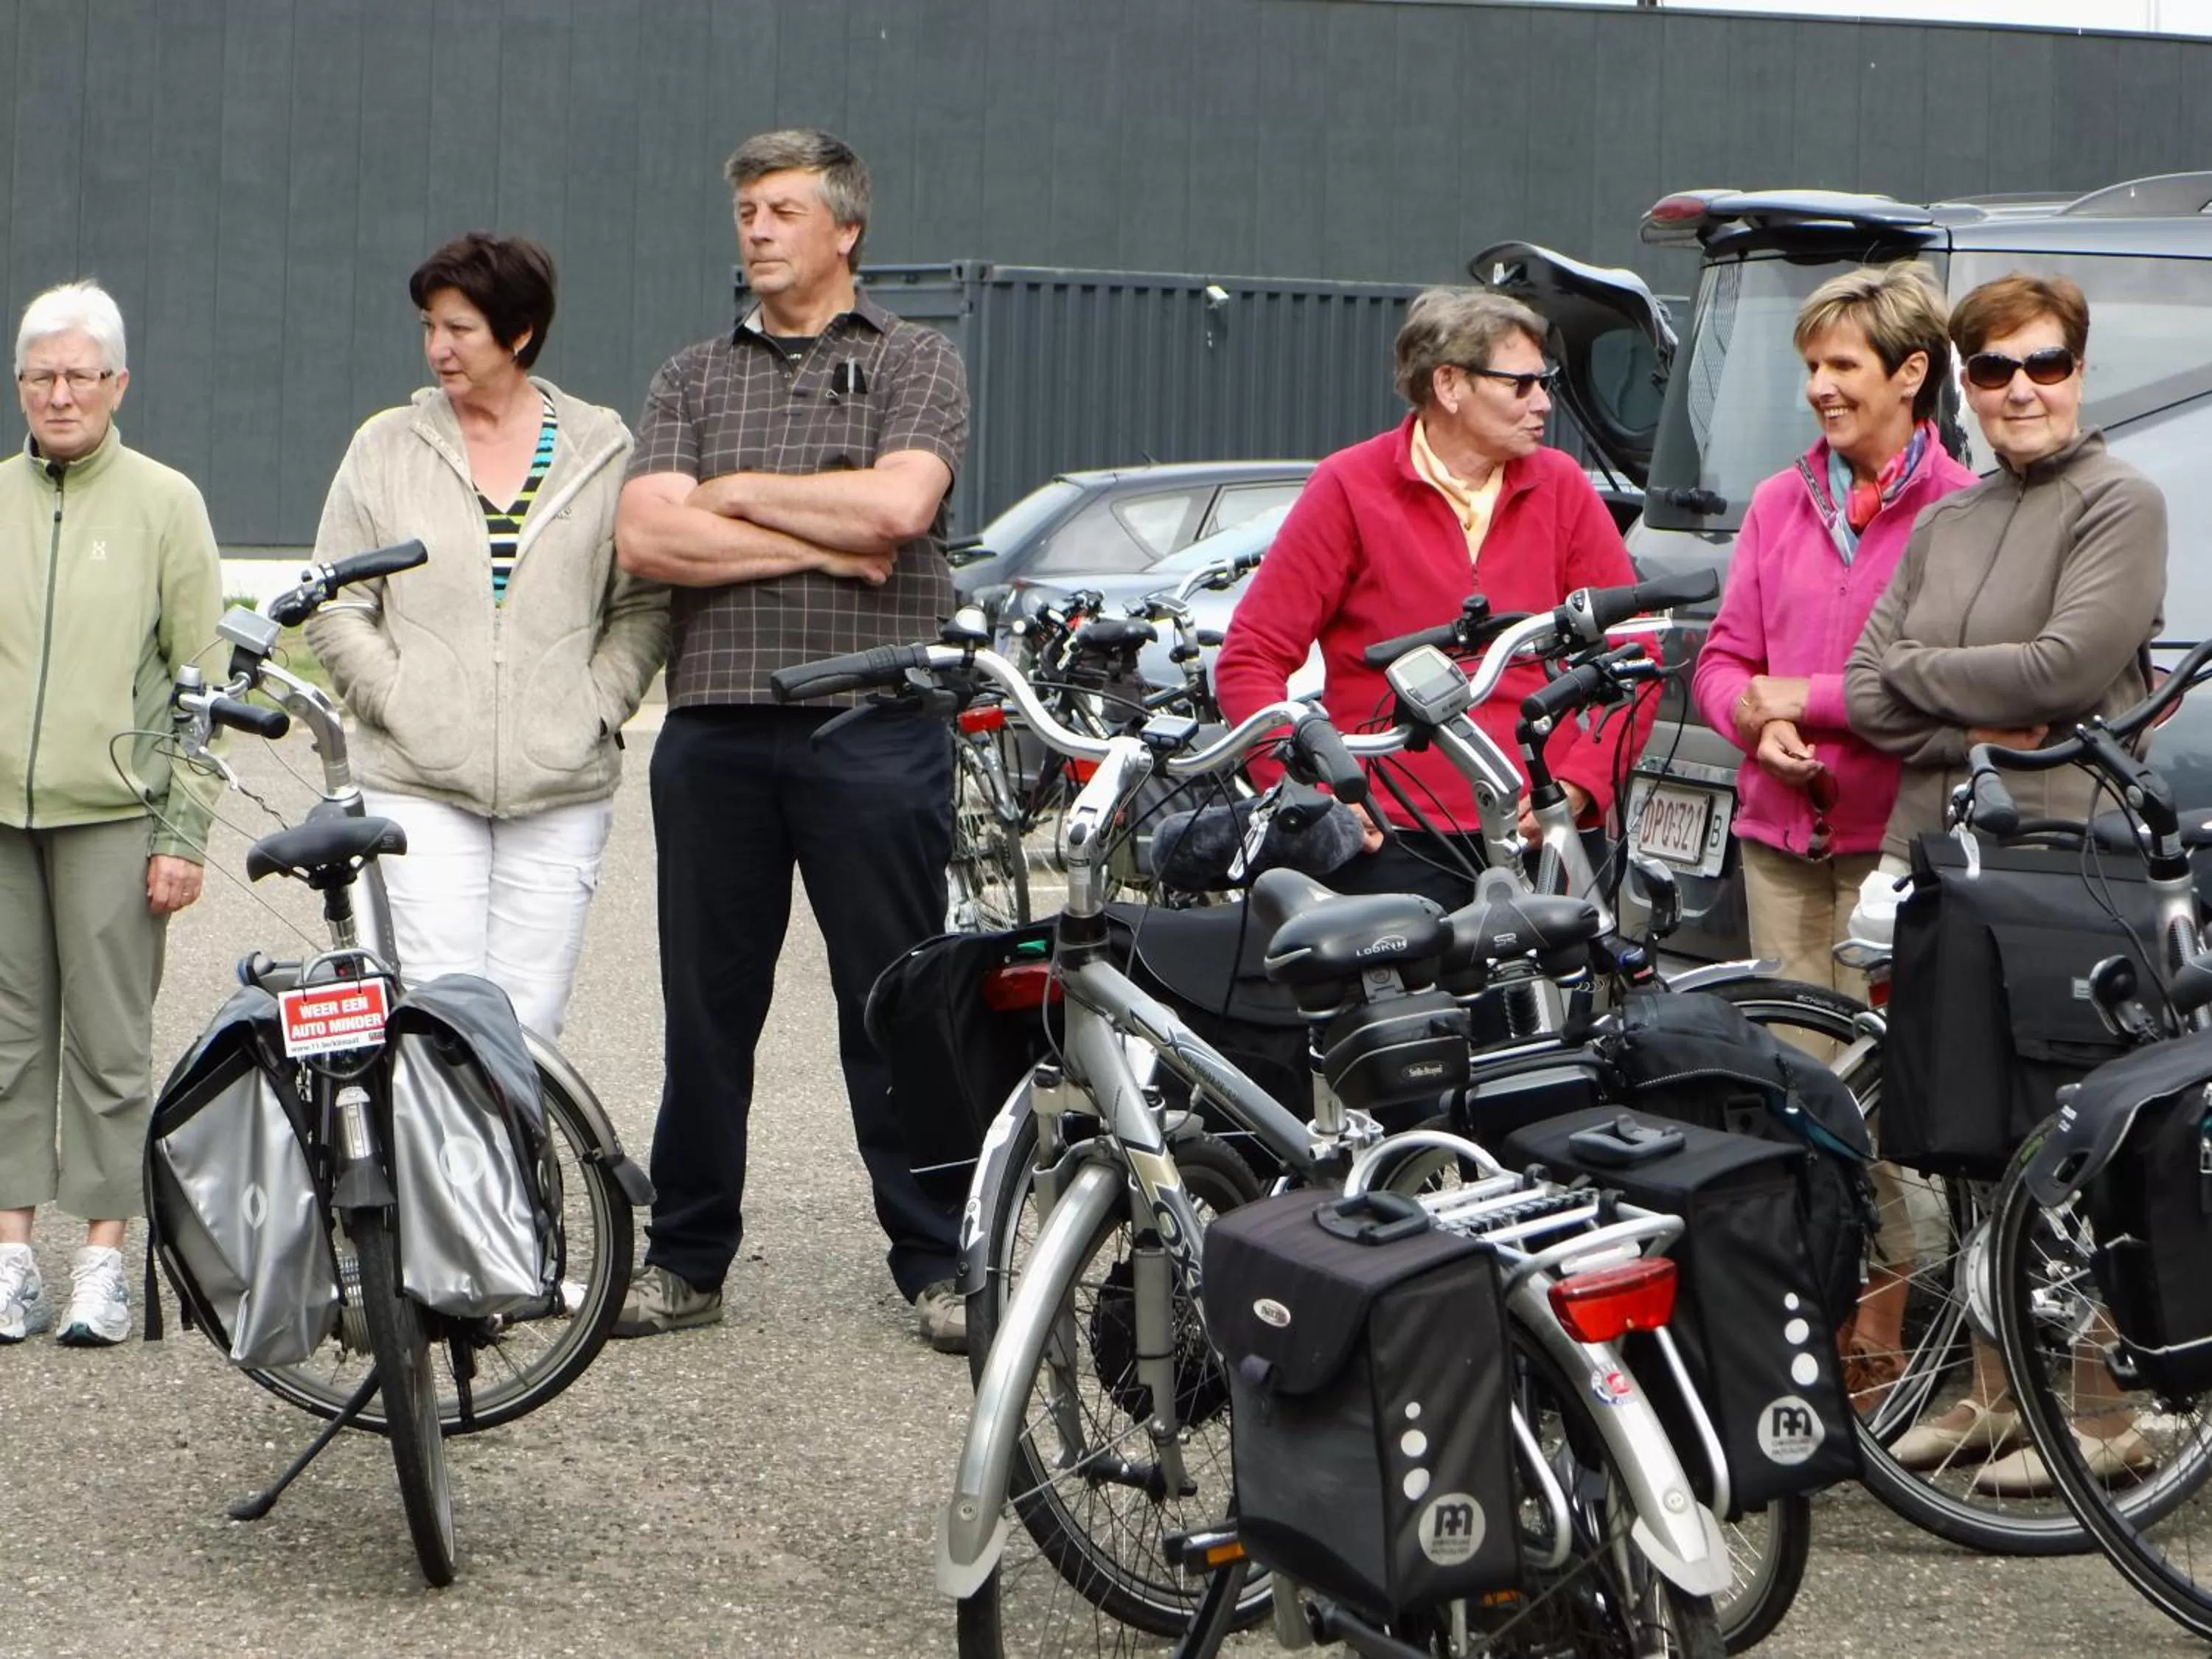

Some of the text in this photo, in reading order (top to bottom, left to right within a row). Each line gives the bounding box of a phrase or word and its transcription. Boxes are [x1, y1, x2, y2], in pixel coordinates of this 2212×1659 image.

[299, 996, 369, 1019] WEER EEN
[291, 1012, 382, 1039] AUTO MINDER
